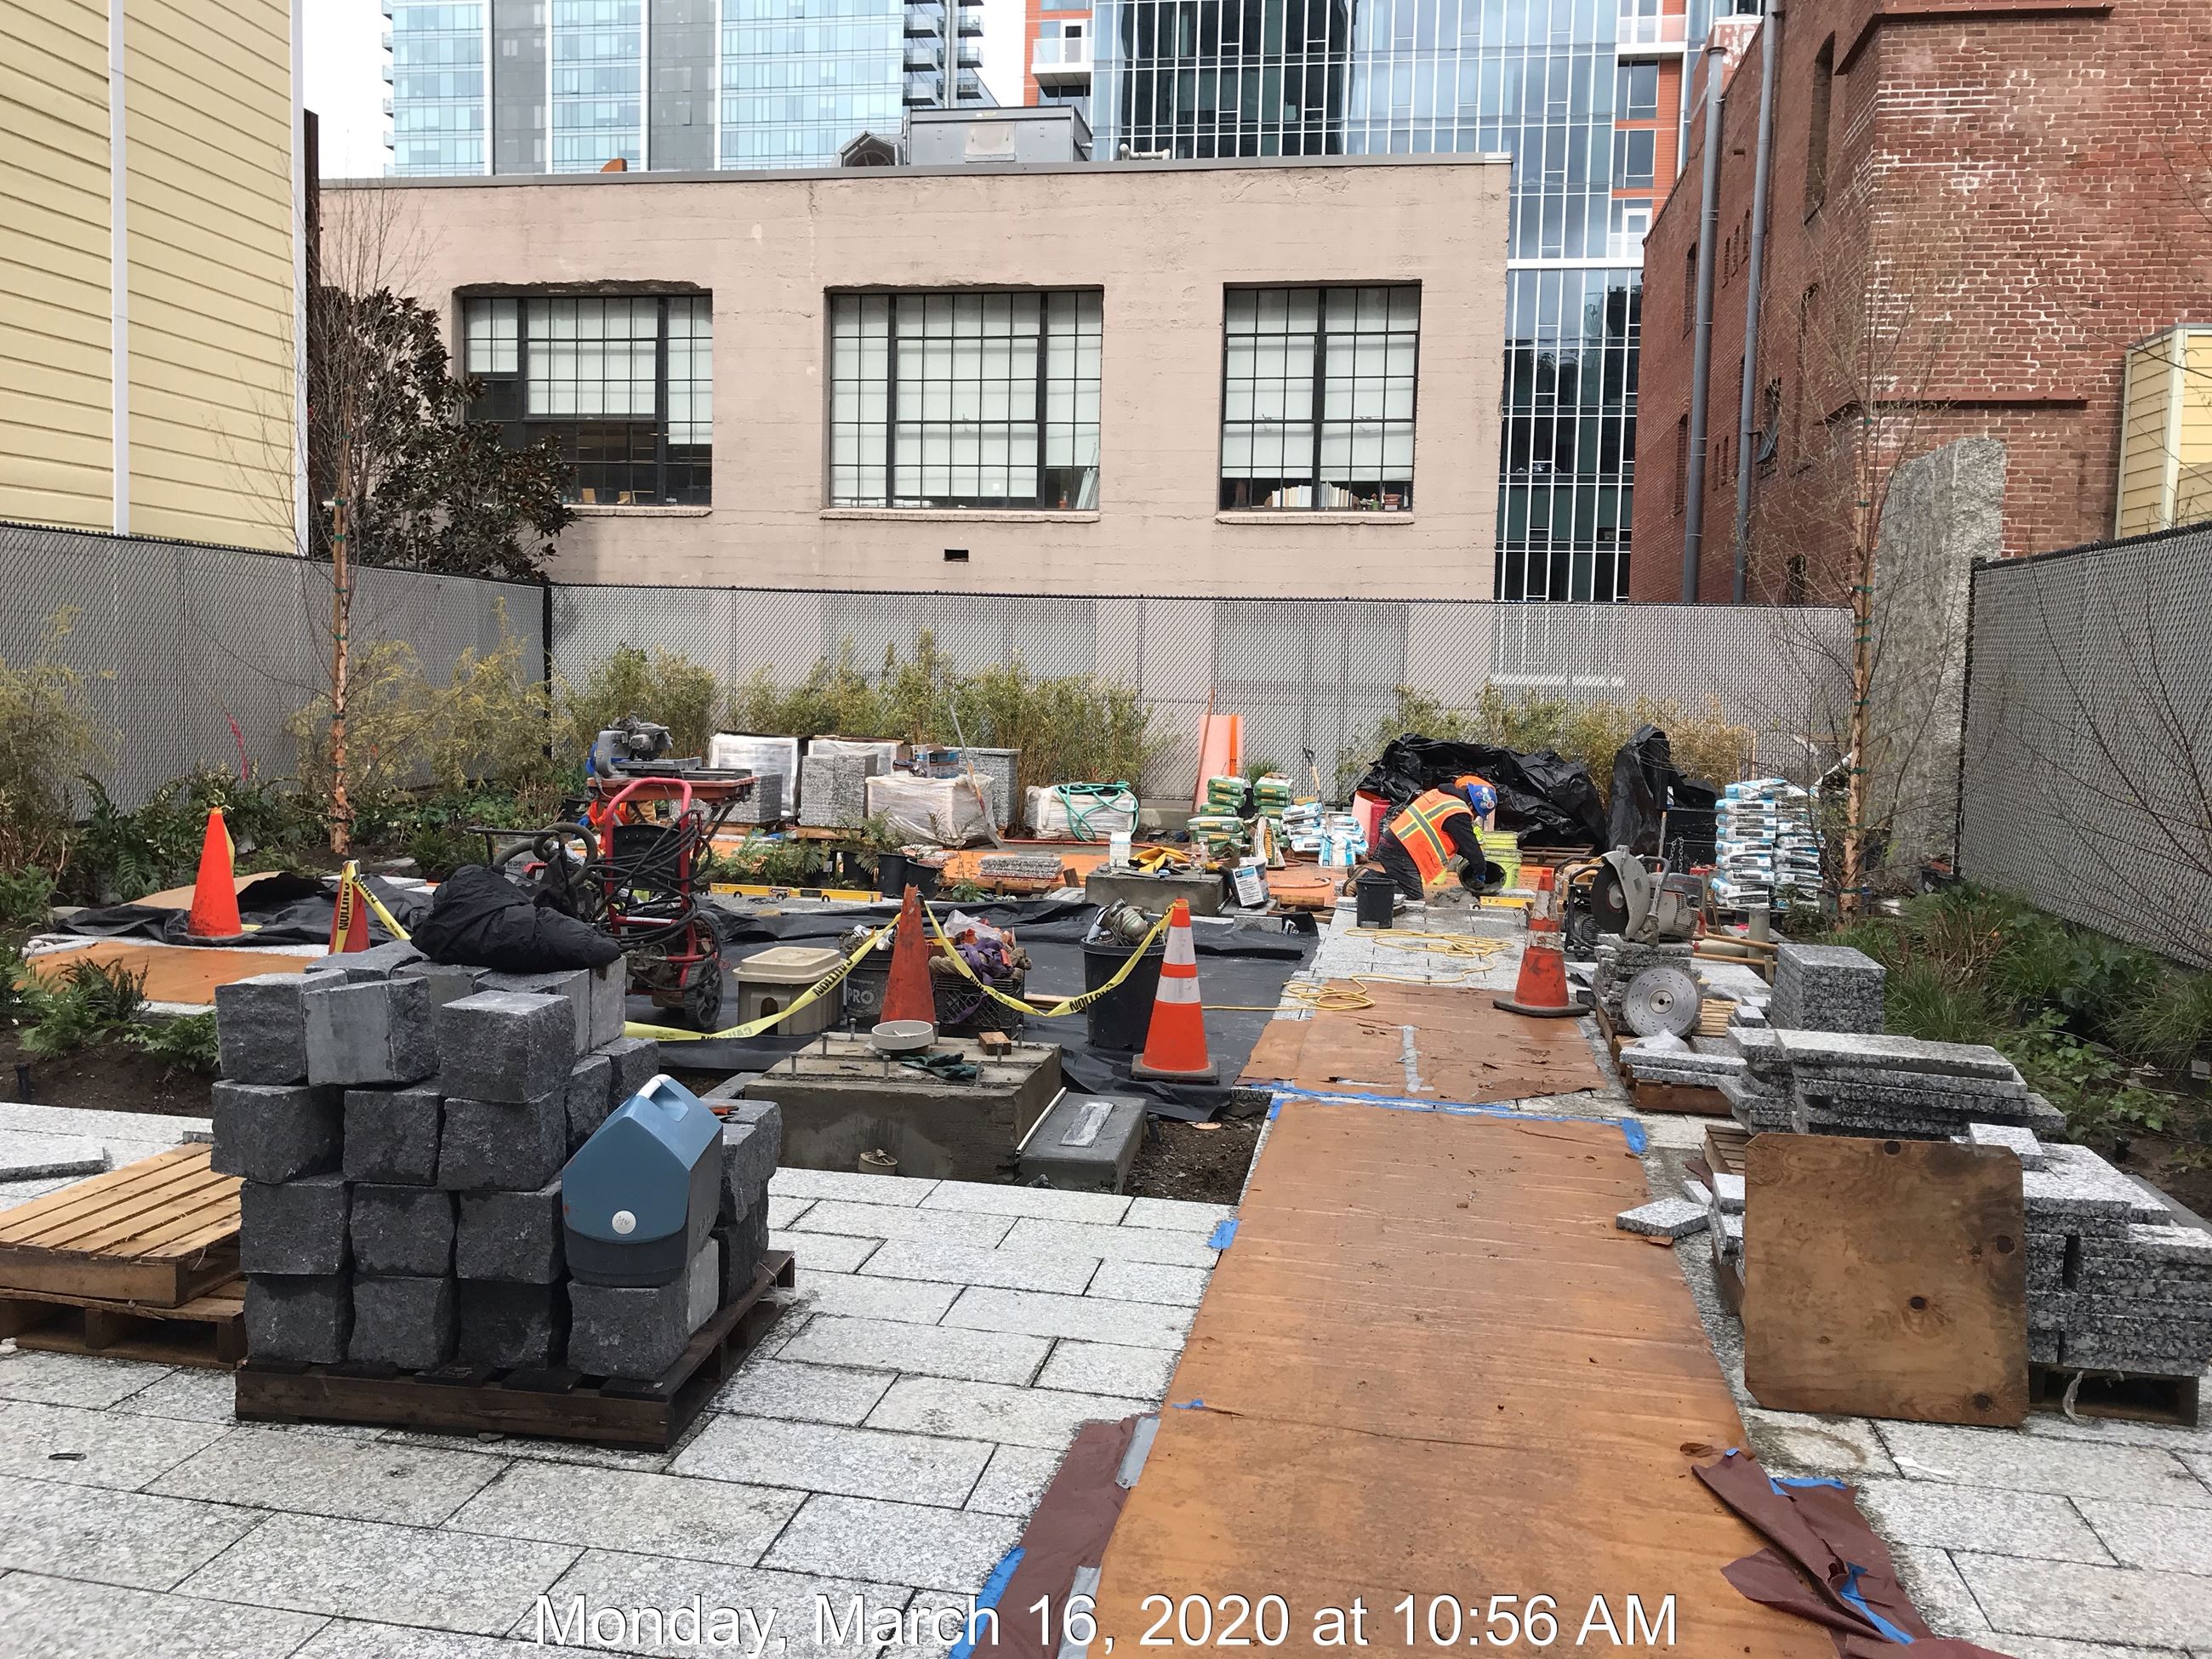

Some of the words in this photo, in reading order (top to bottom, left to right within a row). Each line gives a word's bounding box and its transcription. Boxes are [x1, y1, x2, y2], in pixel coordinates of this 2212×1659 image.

[338, 882, 351, 931] CAUTION
[811, 957, 853, 997] CAUTION
[847, 987, 874, 1005] PRO
